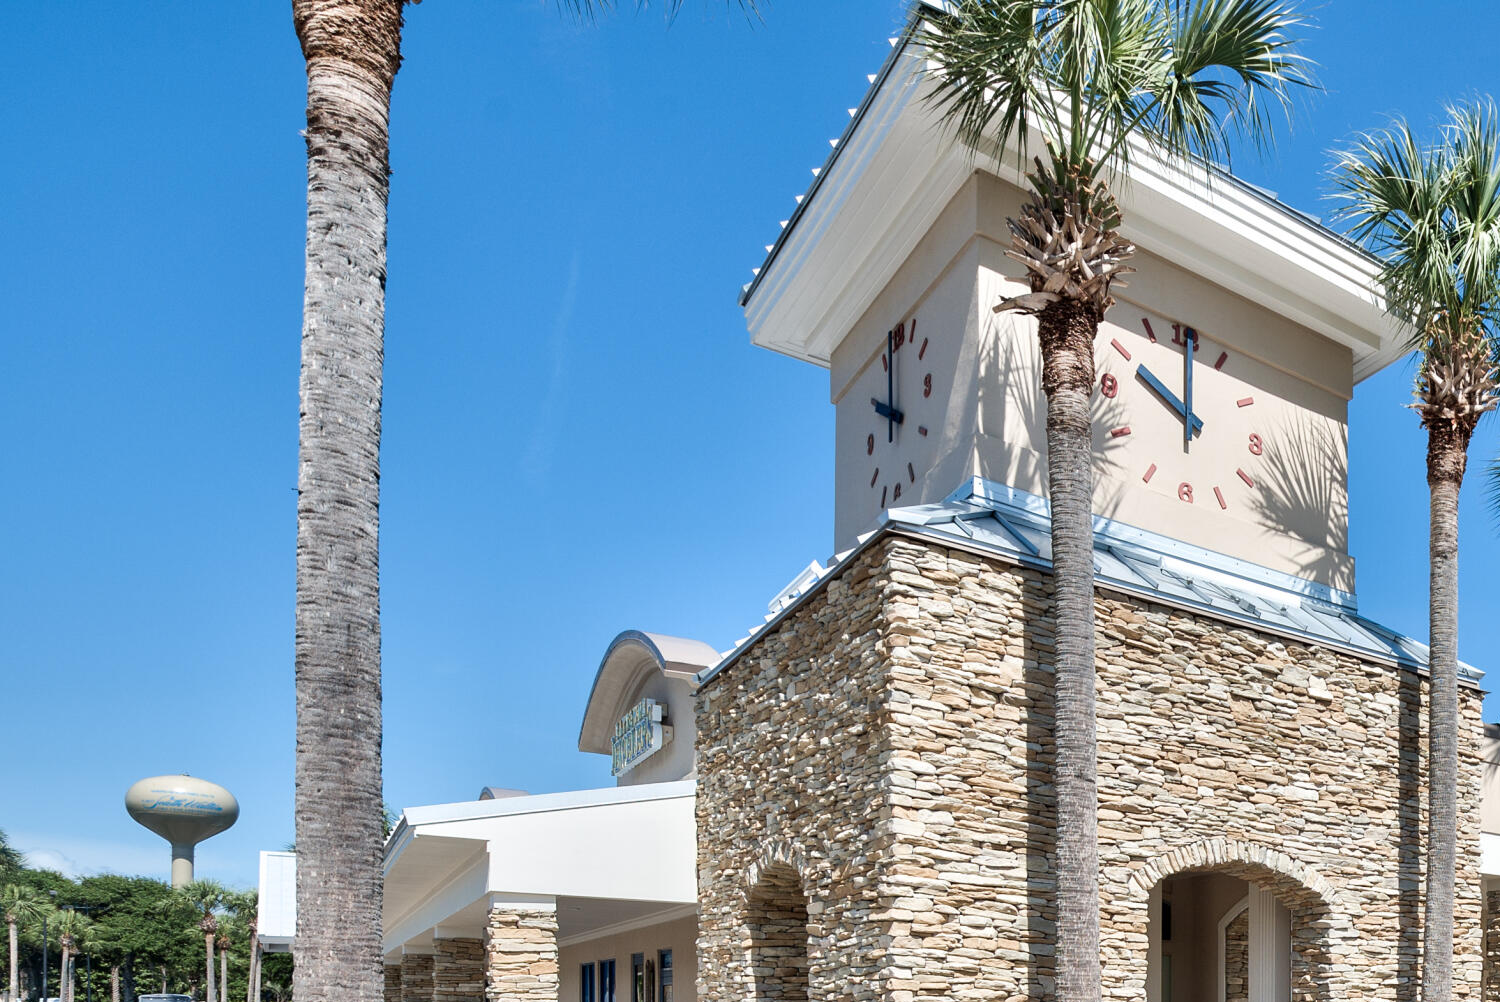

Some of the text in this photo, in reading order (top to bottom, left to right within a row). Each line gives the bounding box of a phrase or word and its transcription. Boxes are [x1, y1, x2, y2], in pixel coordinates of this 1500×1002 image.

[1101, 373, 1118, 398] 9
[1249, 433, 1263, 455] 3
[1178, 482, 1193, 503] 6
